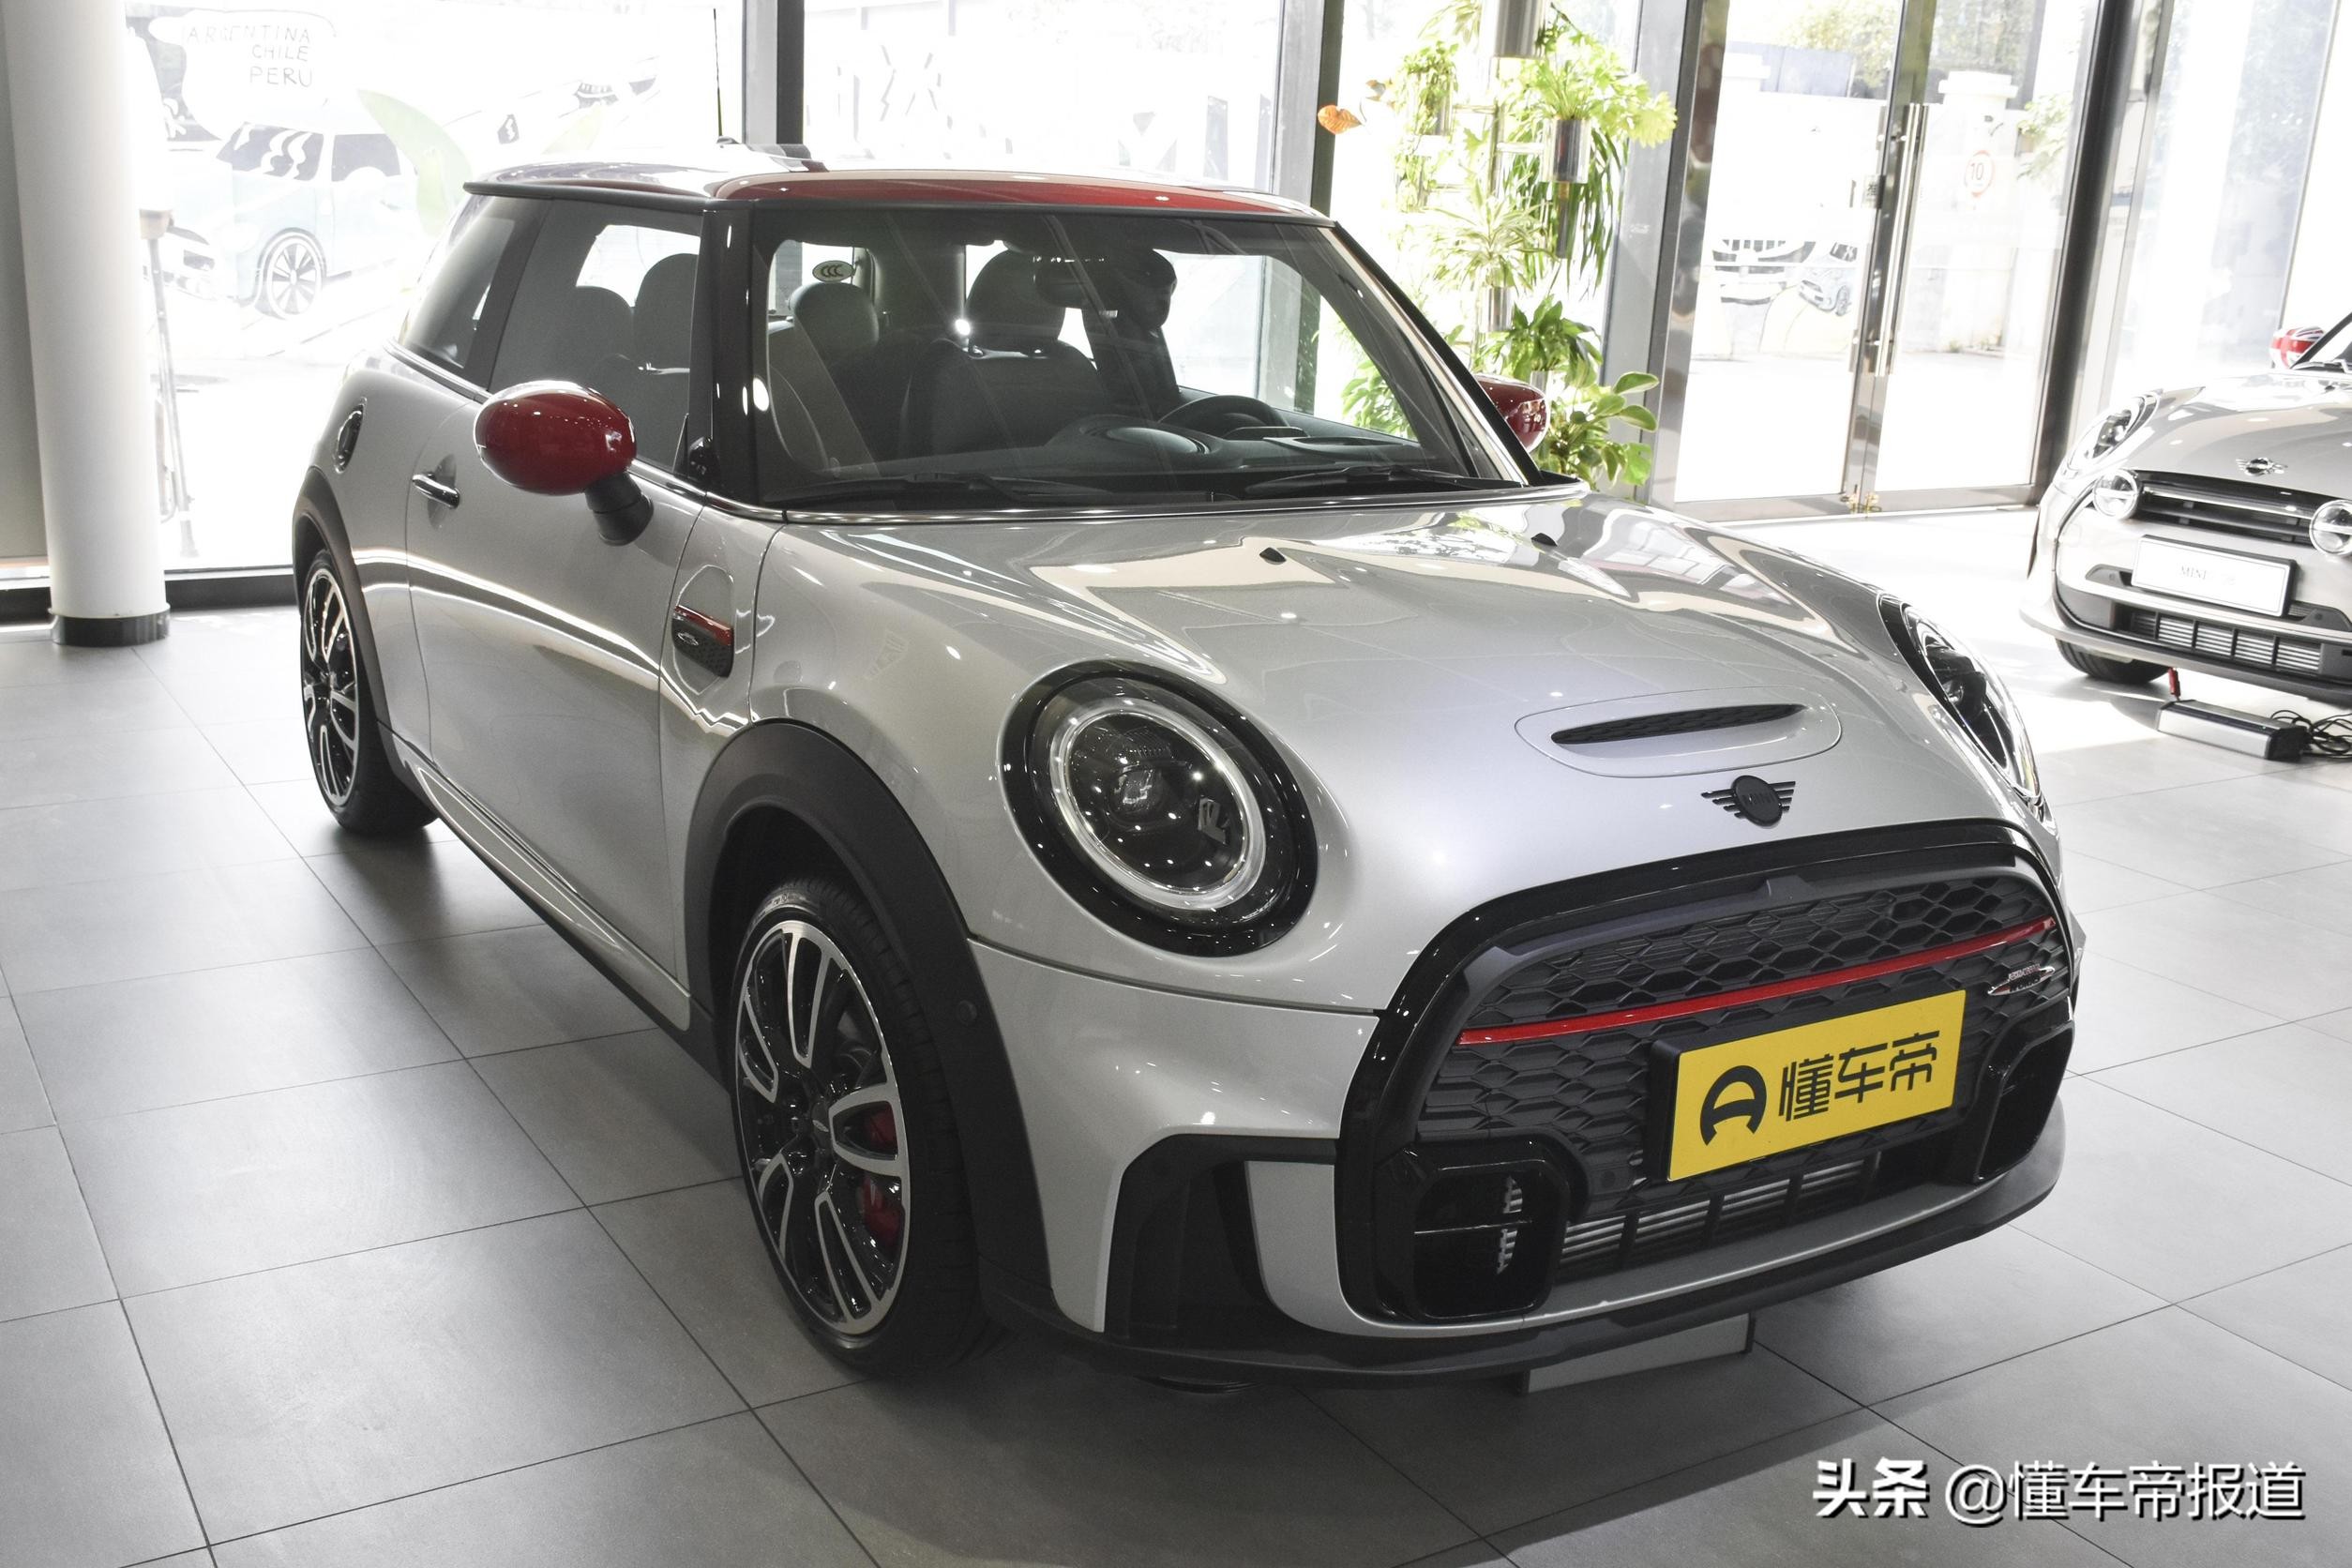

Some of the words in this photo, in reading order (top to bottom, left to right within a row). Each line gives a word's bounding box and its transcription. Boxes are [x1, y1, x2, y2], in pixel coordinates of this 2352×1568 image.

[252, 45, 309, 61] CHILE
[250, 67, 311, 87] PERU
[1971, 163, 1984, 180] 10
[1778, 1030, 1940, 1122] 懂车帝
